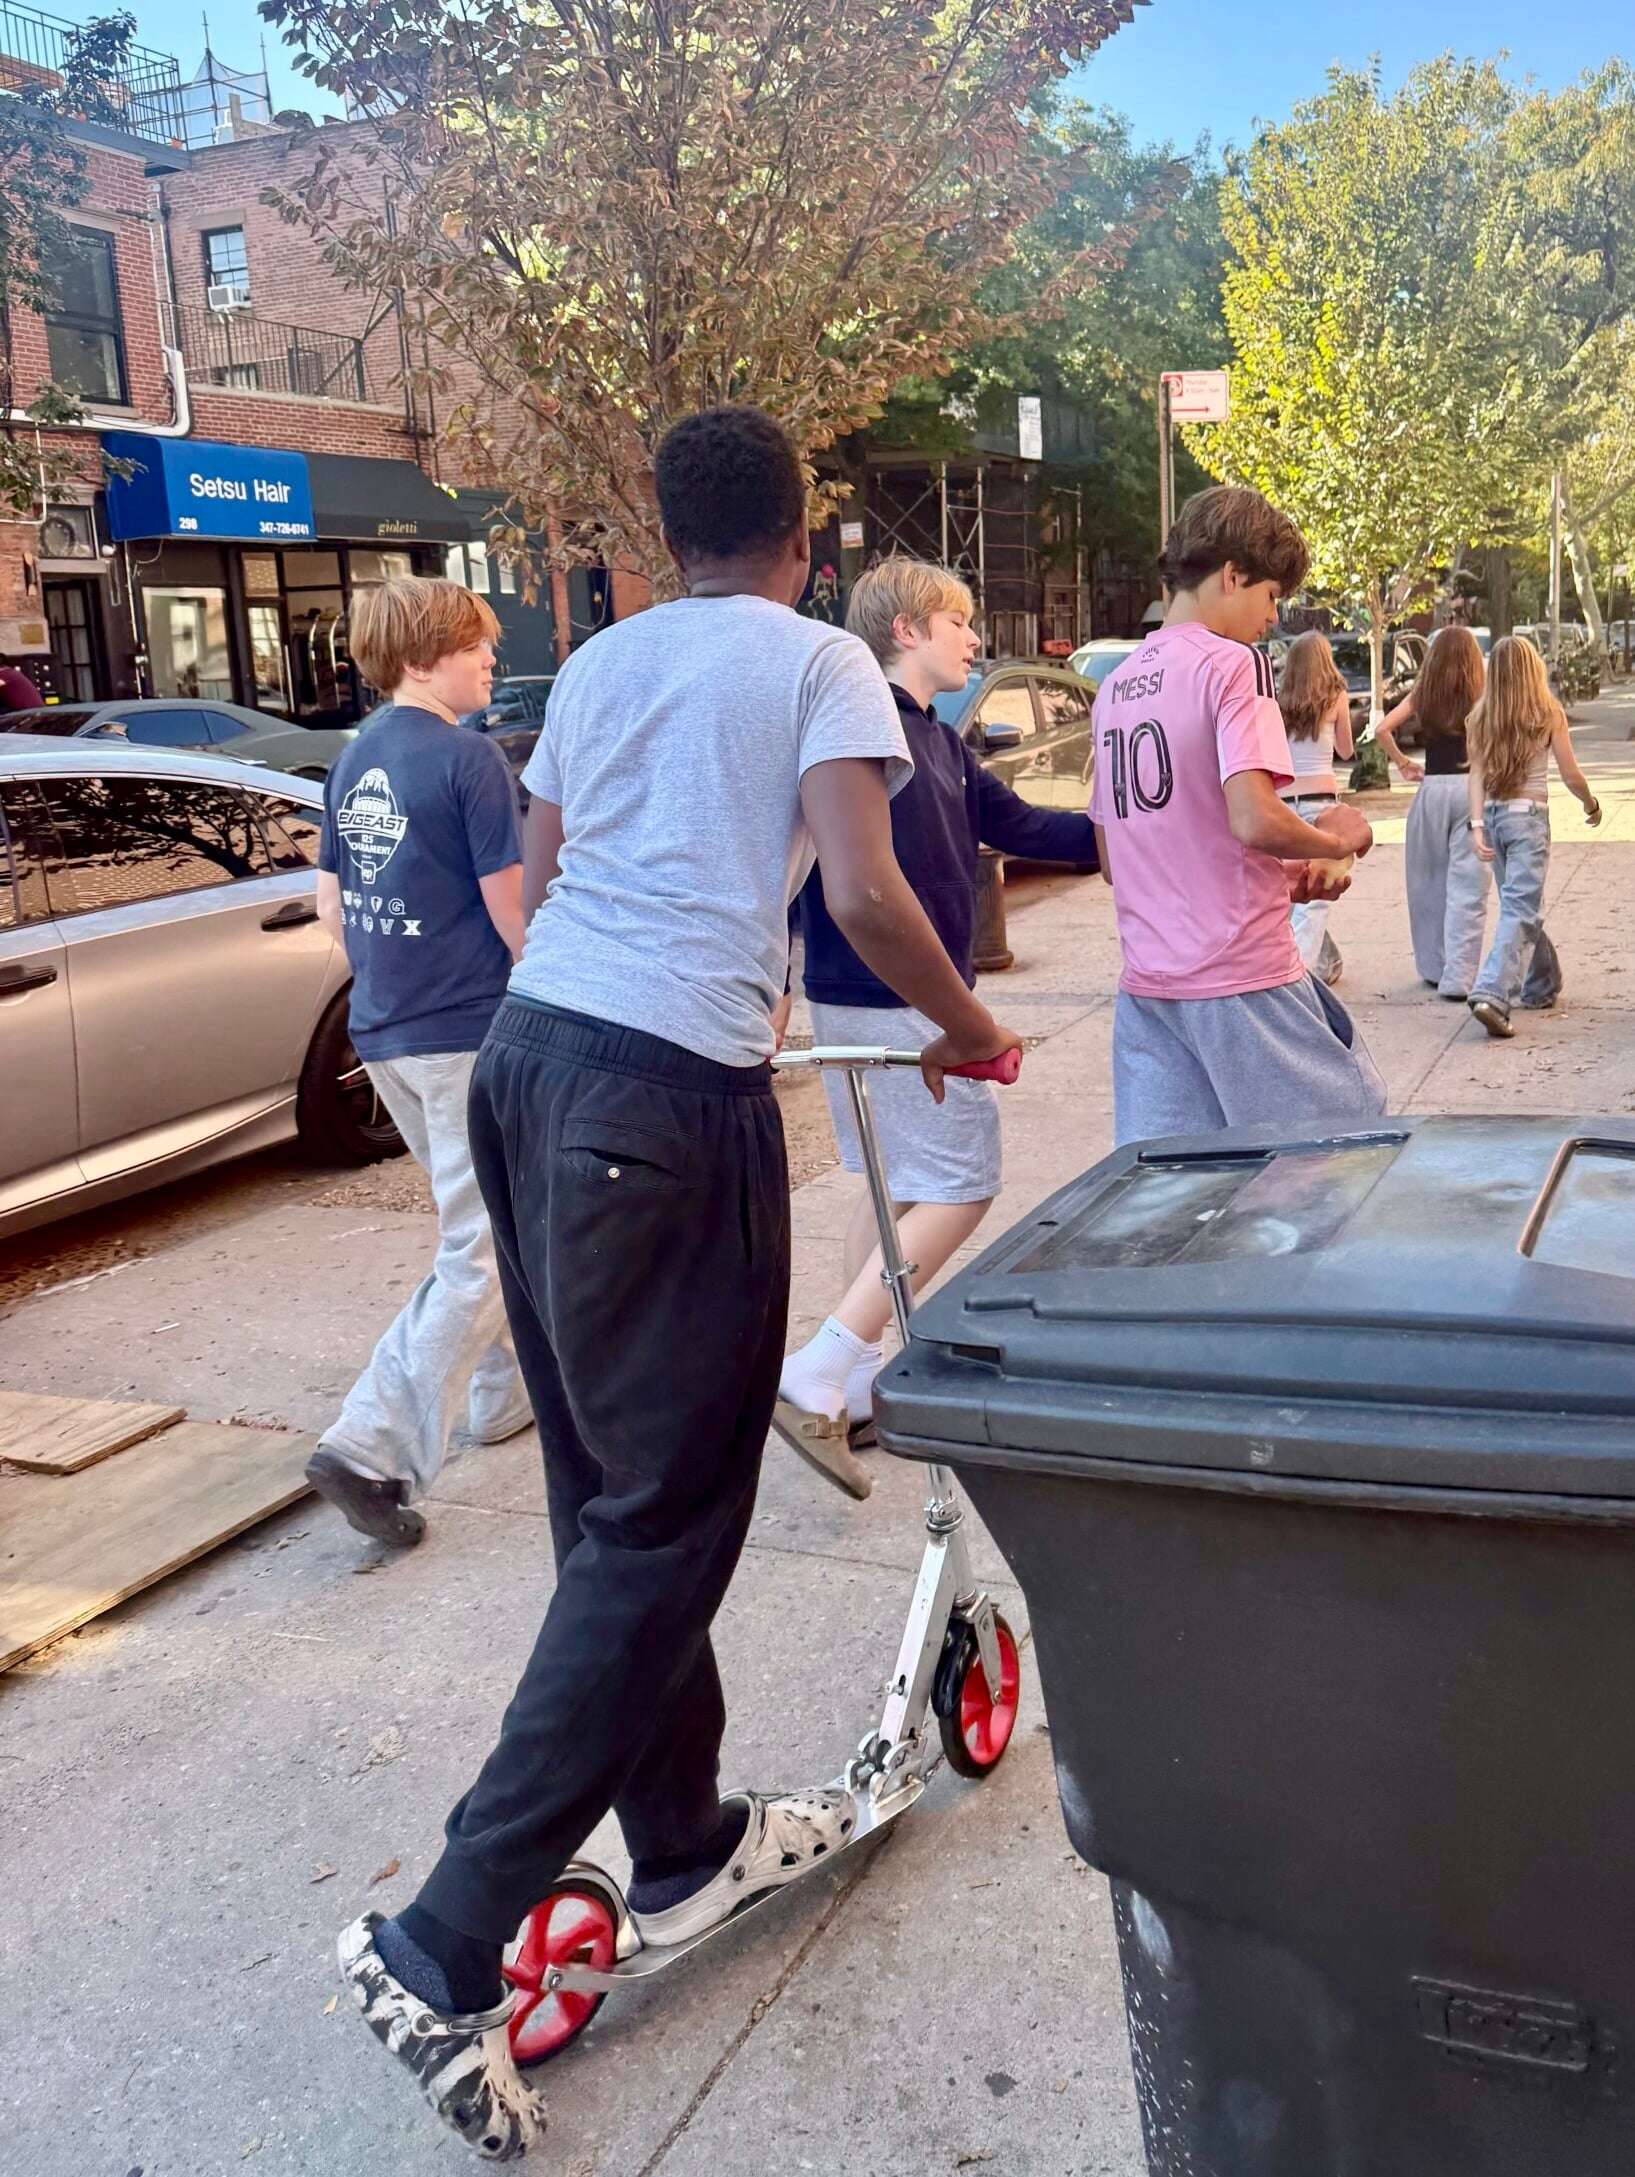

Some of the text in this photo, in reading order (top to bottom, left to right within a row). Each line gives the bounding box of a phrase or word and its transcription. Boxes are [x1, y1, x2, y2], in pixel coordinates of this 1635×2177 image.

[189, 473, 291, 503] Setsu Hair
[1111, 668, 1165, 705] MESSI
[1103, 718, 1174, 820] 10
